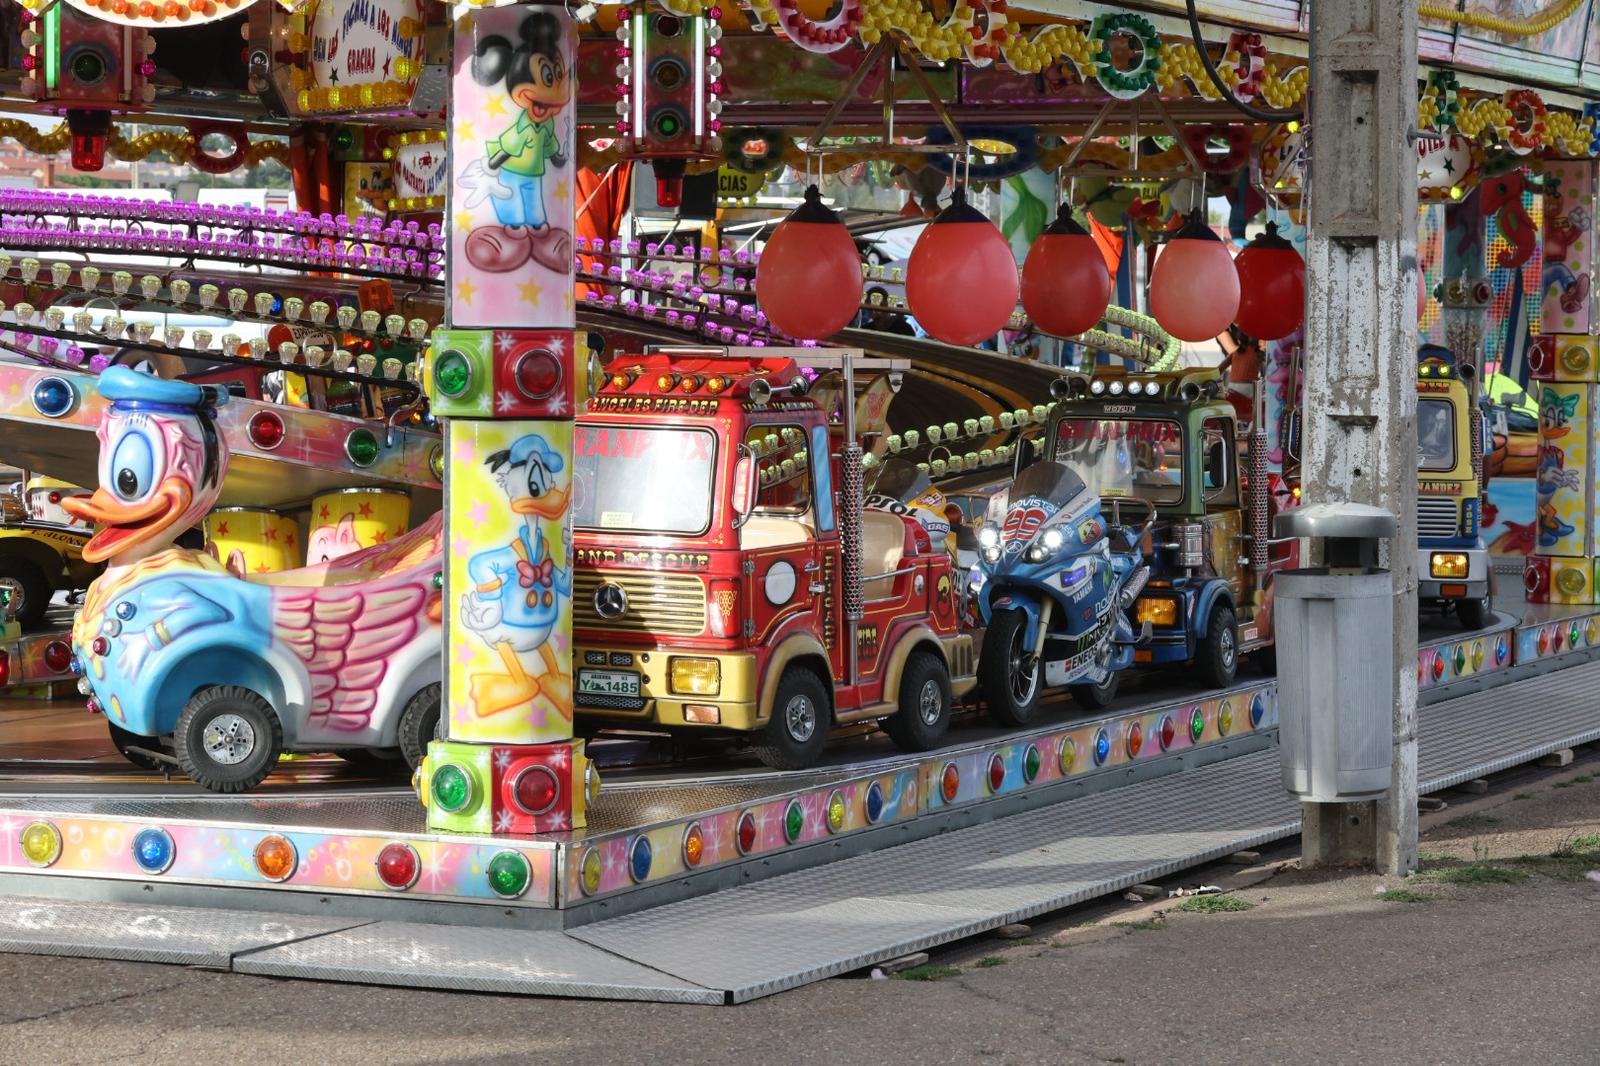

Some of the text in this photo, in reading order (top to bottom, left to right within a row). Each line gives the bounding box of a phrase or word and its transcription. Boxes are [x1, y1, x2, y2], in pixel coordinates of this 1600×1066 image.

[1127, 420, 1177, 443] PRIX
[928, 523, 948, 533] GAS
[622, 550, 709, 571] RESCUE
[1072, 642, 1098, 670] ENEOS
[606, 681, 638, 693] 1485
